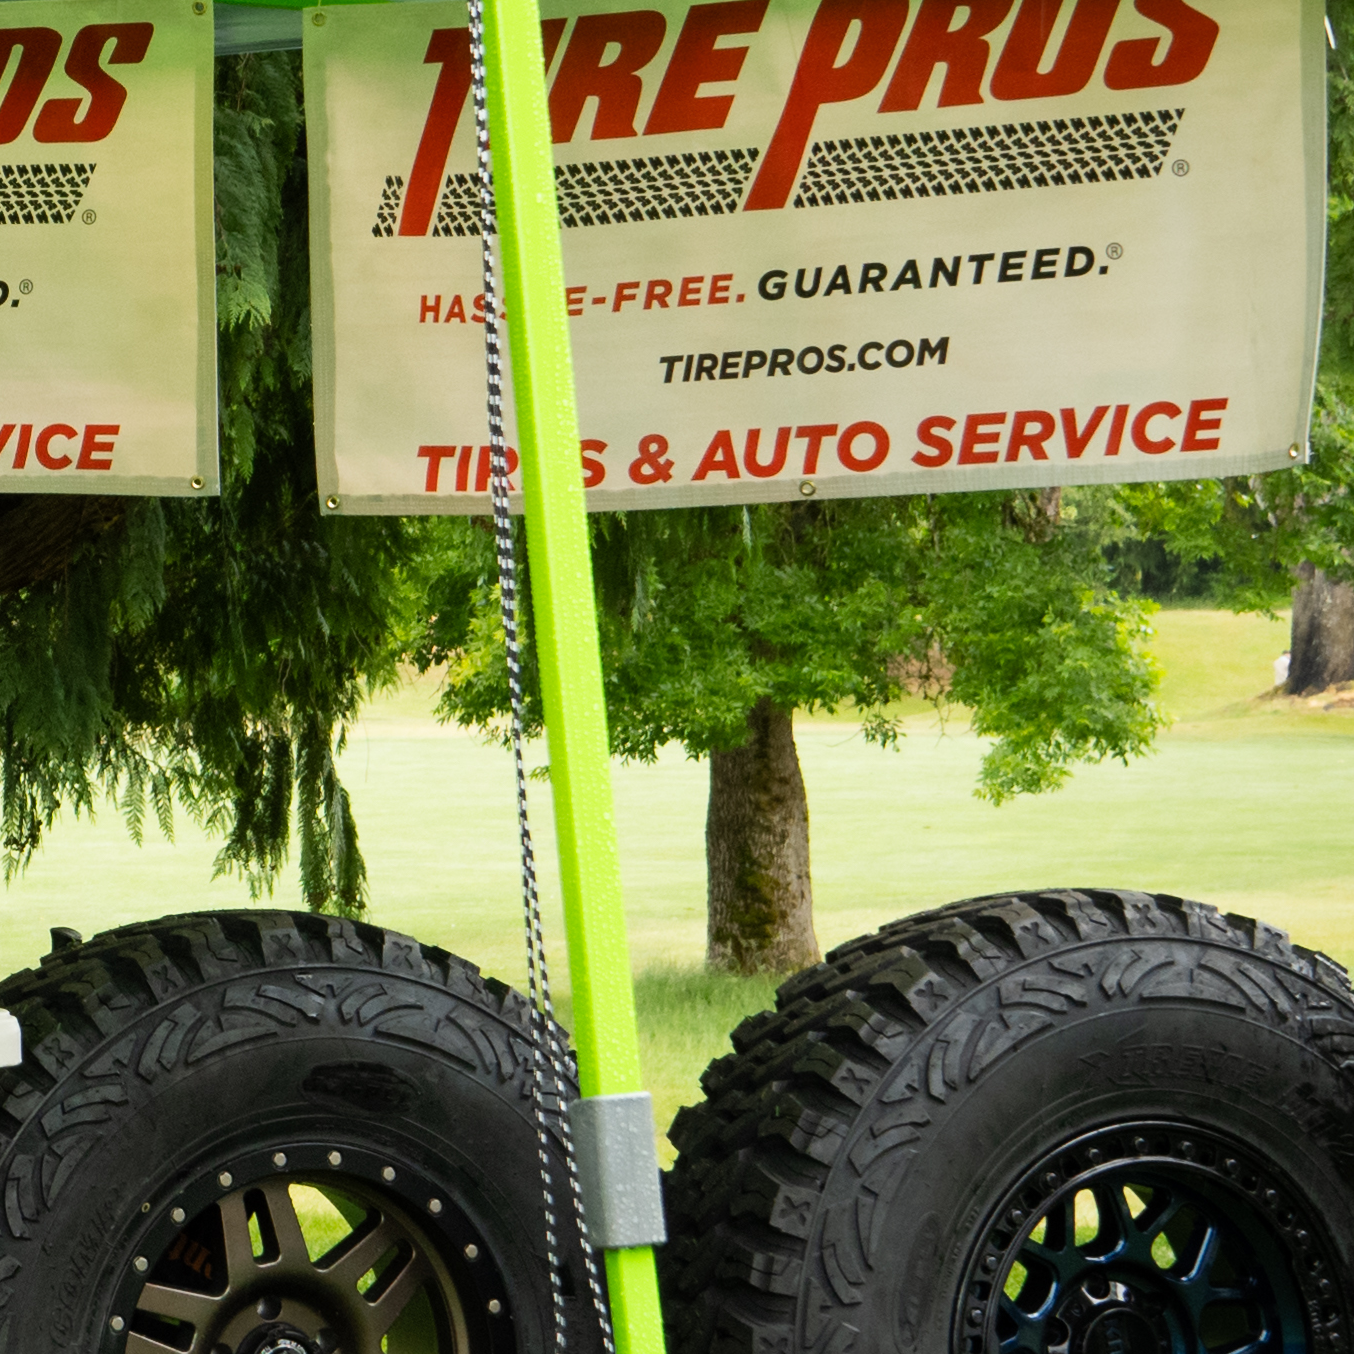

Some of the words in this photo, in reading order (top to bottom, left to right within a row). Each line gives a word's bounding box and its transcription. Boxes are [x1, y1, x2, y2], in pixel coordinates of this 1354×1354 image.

[420, 274, 745, 323] HASE-FREE.
[660, 337, 949, 383] TIREPROS.COM
[418, 439, 607, 492] TIRS
[629, 434, 674, 484] &
[692, 421, 890, 480] AUTO
[912, 398, 1228, 467] SERVICE
